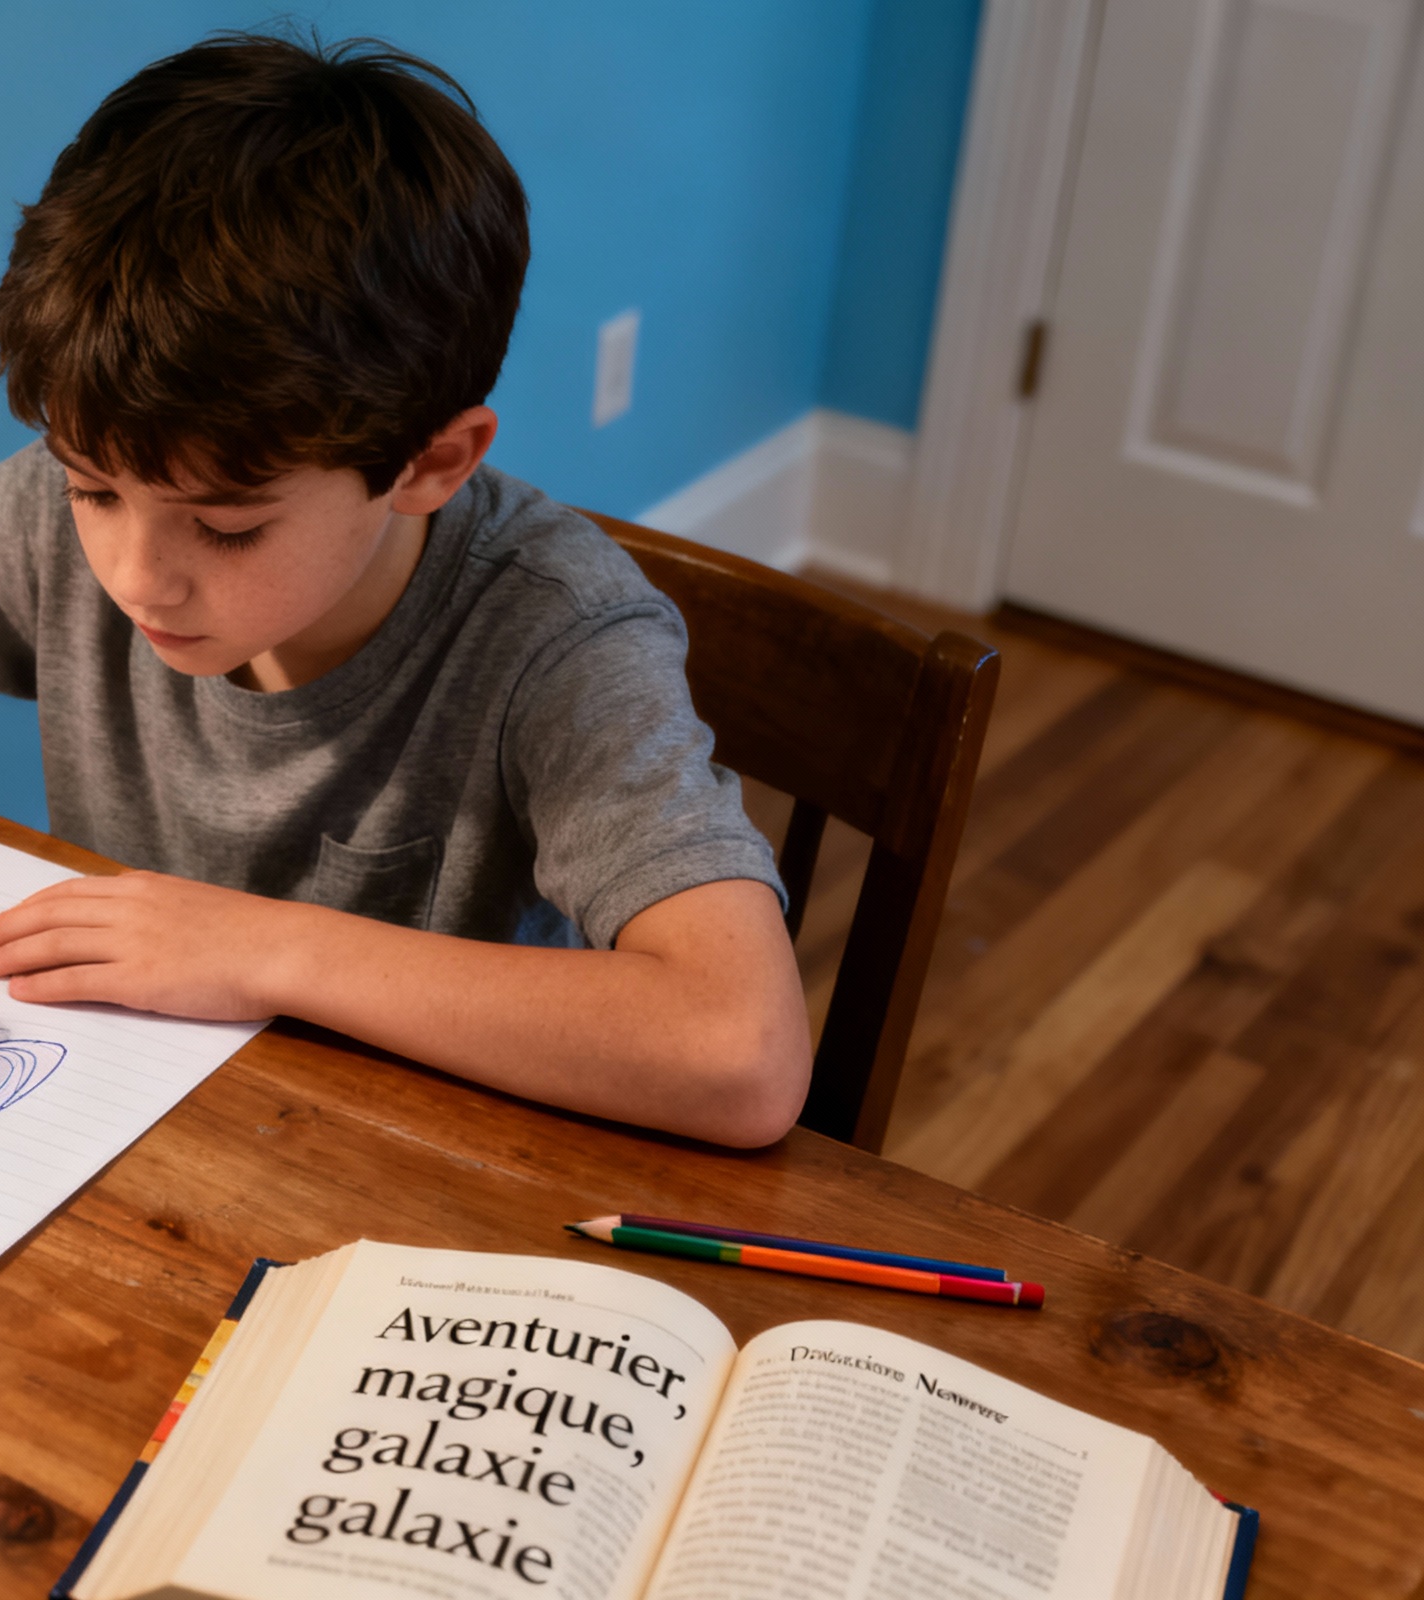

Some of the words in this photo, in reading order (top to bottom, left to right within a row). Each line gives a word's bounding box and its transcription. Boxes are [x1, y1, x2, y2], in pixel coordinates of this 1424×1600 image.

[375, 1306, 688, 1421] Aventurier,
[322, 1420, 576, 1507] galaxie
[353, 1364, 645, 1468] magique,
[285, 1487, 554, 1586] galaxie
